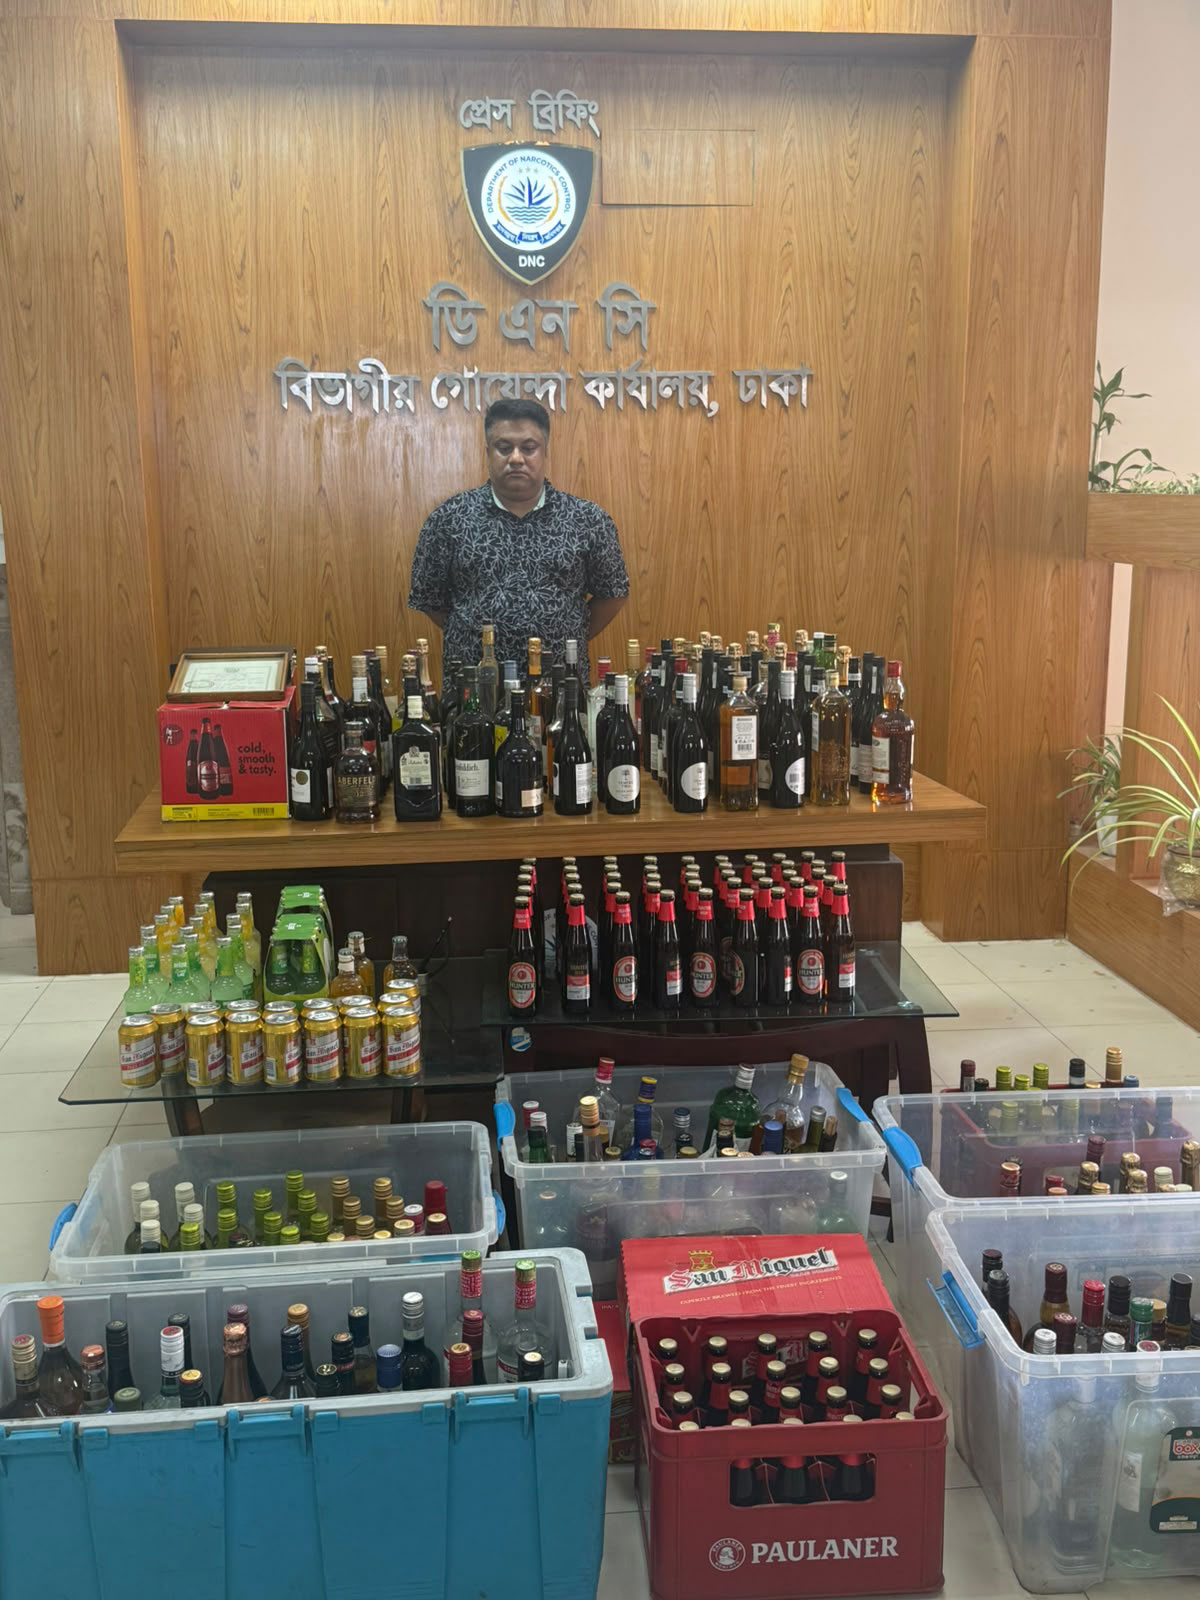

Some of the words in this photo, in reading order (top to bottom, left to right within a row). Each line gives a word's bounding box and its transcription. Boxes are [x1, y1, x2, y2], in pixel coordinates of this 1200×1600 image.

[459, 95, 516, 131] প্রেস
[528, 88, 601, 138] ব্রিফিং
[486, 163, 508, 214] DEPARTMENT
[508, 156, 519, 166] OF
[520, 155, 560, 176] NARCOTICS
[558, 175, 571, 214] CONTROL
[518, 255, 546, 267] DNC
[423, 281, 486, 352] ডি
[500, 299, 579, 352] এন
[595, 281, 656, 352] সি
[273, 357, 421, 414] বিভাগীয়
[579, 357, 720, 418] কার্যালয়,
[732, 362, 814, 409] ঢাকা
[238, 741, 266, 755] cold,
[238, 752, 275, 764] smooth
[238, 763, 247, 774] &
[249, 765, 277, 777] tasty.
[668, 1268, 728, 1290] San
[730, 1248, 829, 1280] Miguel
[751, 1536, 899, 1565] PAULANER
